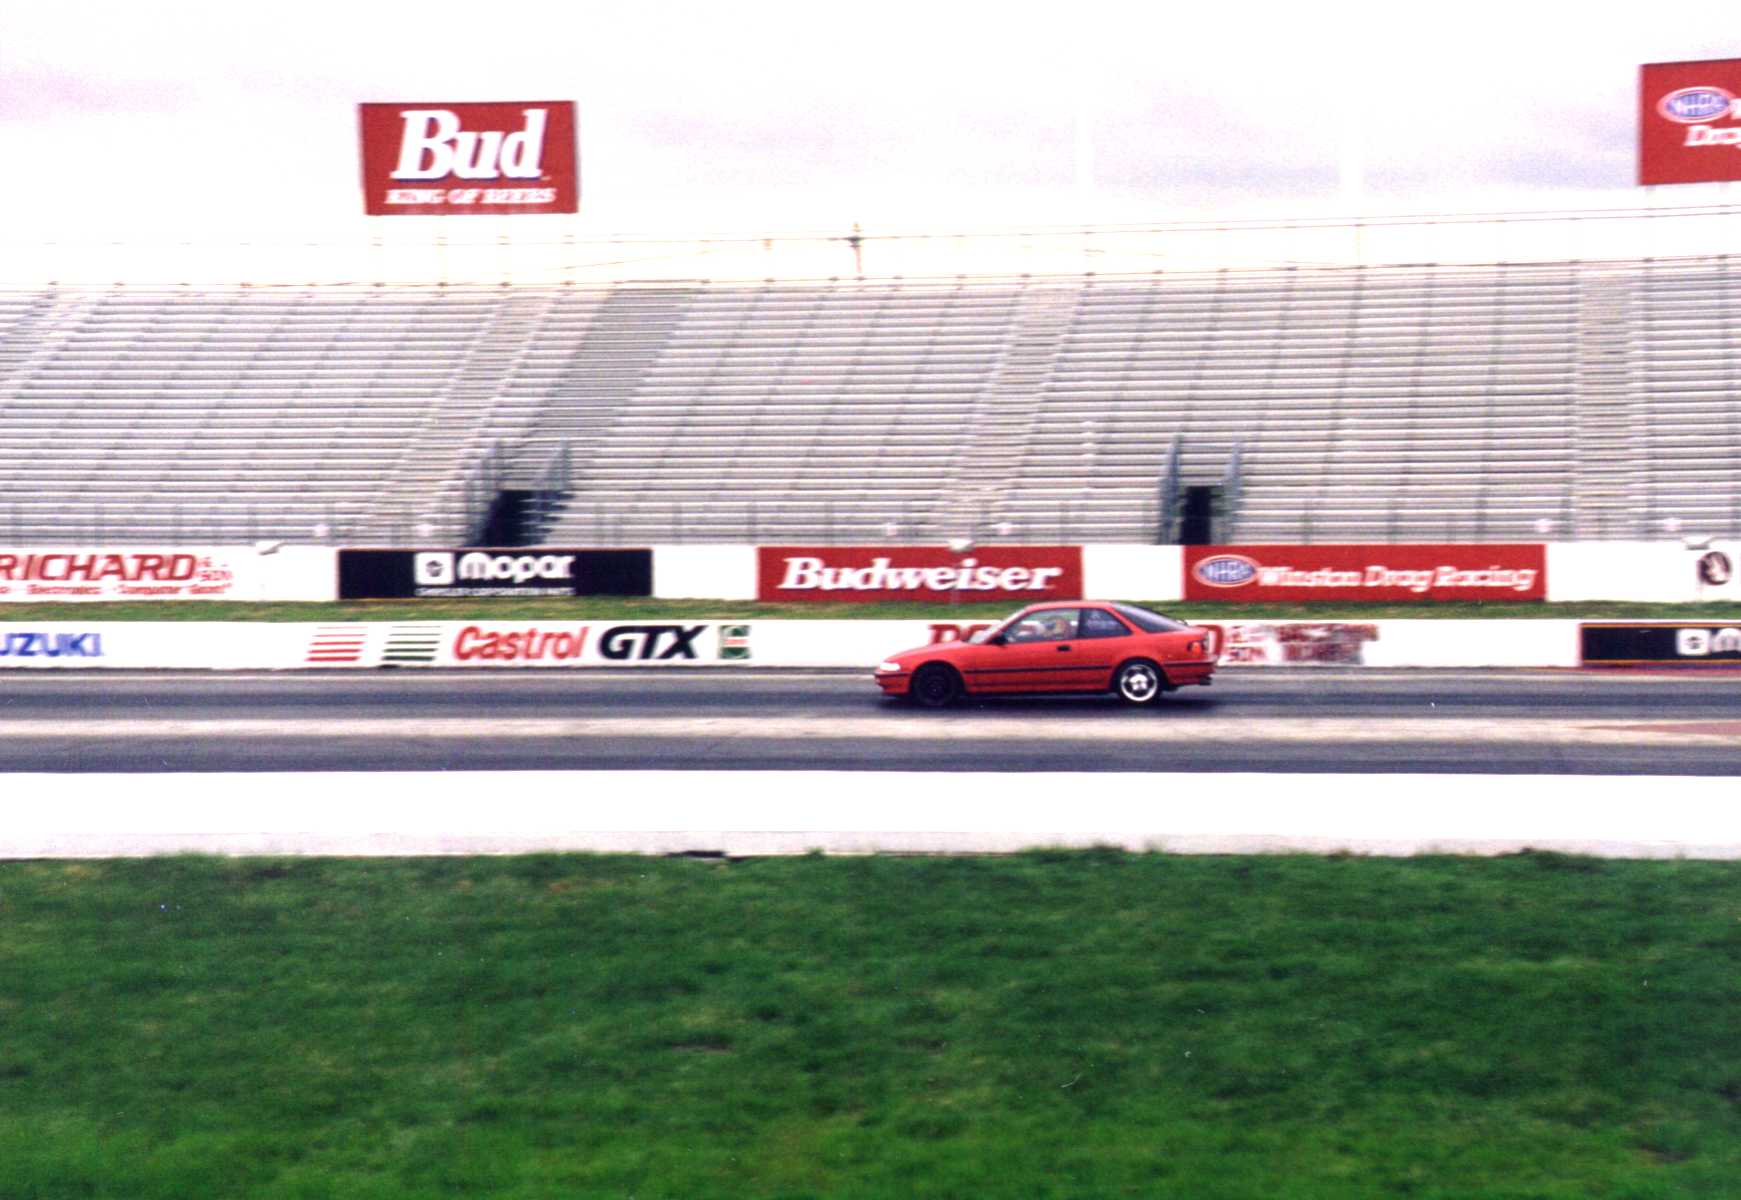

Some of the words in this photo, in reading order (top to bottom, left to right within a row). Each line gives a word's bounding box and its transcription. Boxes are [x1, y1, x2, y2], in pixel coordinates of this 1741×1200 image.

[389, 108, 547, 182] Bud
[0, 554, 197, 581] RICHARD
[776, 557, 1063, 590] Budweiser
[1256, 566, 1362, 587] Winston
[1364, 565, 1435, 593] Drag
[1434, 565, 1538, 592] Racing
[453, 626, 591, 660] Castrol
[598, 625, 708, 659] GTX
